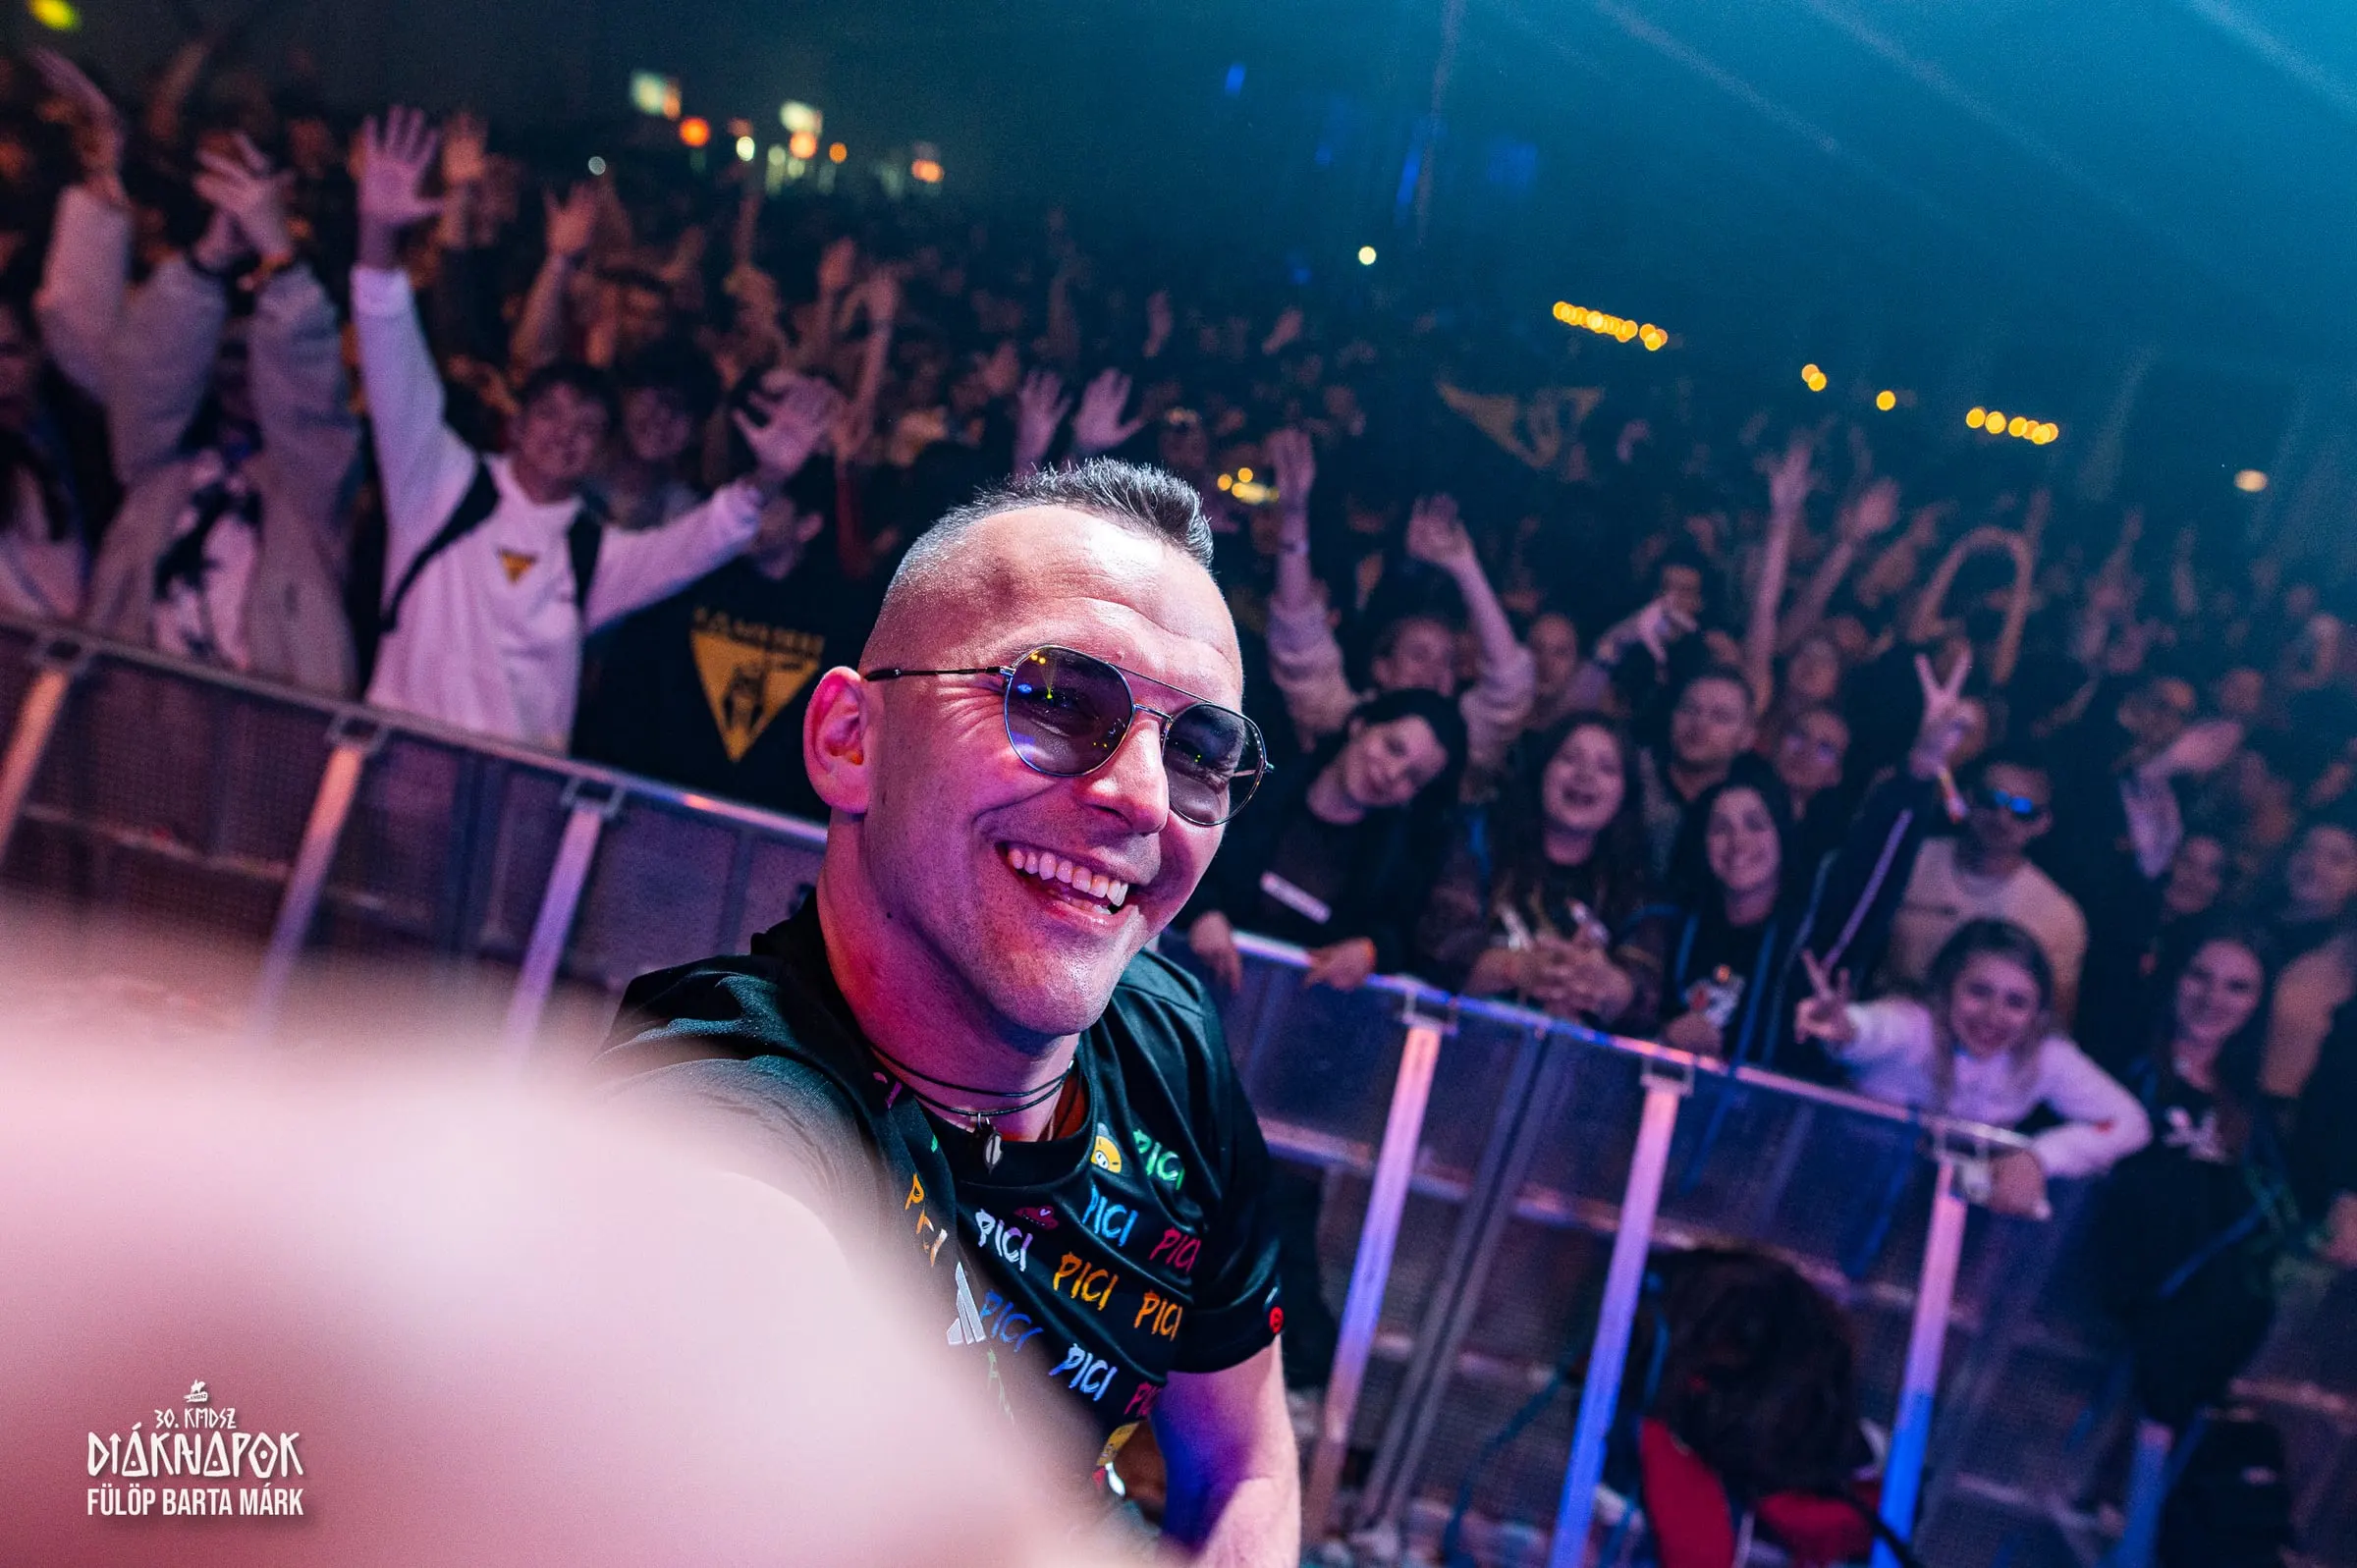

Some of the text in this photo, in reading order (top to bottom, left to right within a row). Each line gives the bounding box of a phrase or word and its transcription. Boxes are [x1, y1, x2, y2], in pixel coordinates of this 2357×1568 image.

[1132, 1129, 1185, 1190] PICI
[975, 1209, 1033, 1271] PICI
[1082, 1182, 1139, 1247] PICI
[1148, 1226, 1202, 1274] PICI
[1053, 1252, 1119, 1311] PICI
[980, 1288, 1044, 1353] PICI
[1134, 1290, 1183, 1341] PICI
[1049, 1343, 1118, 1401] PICI
